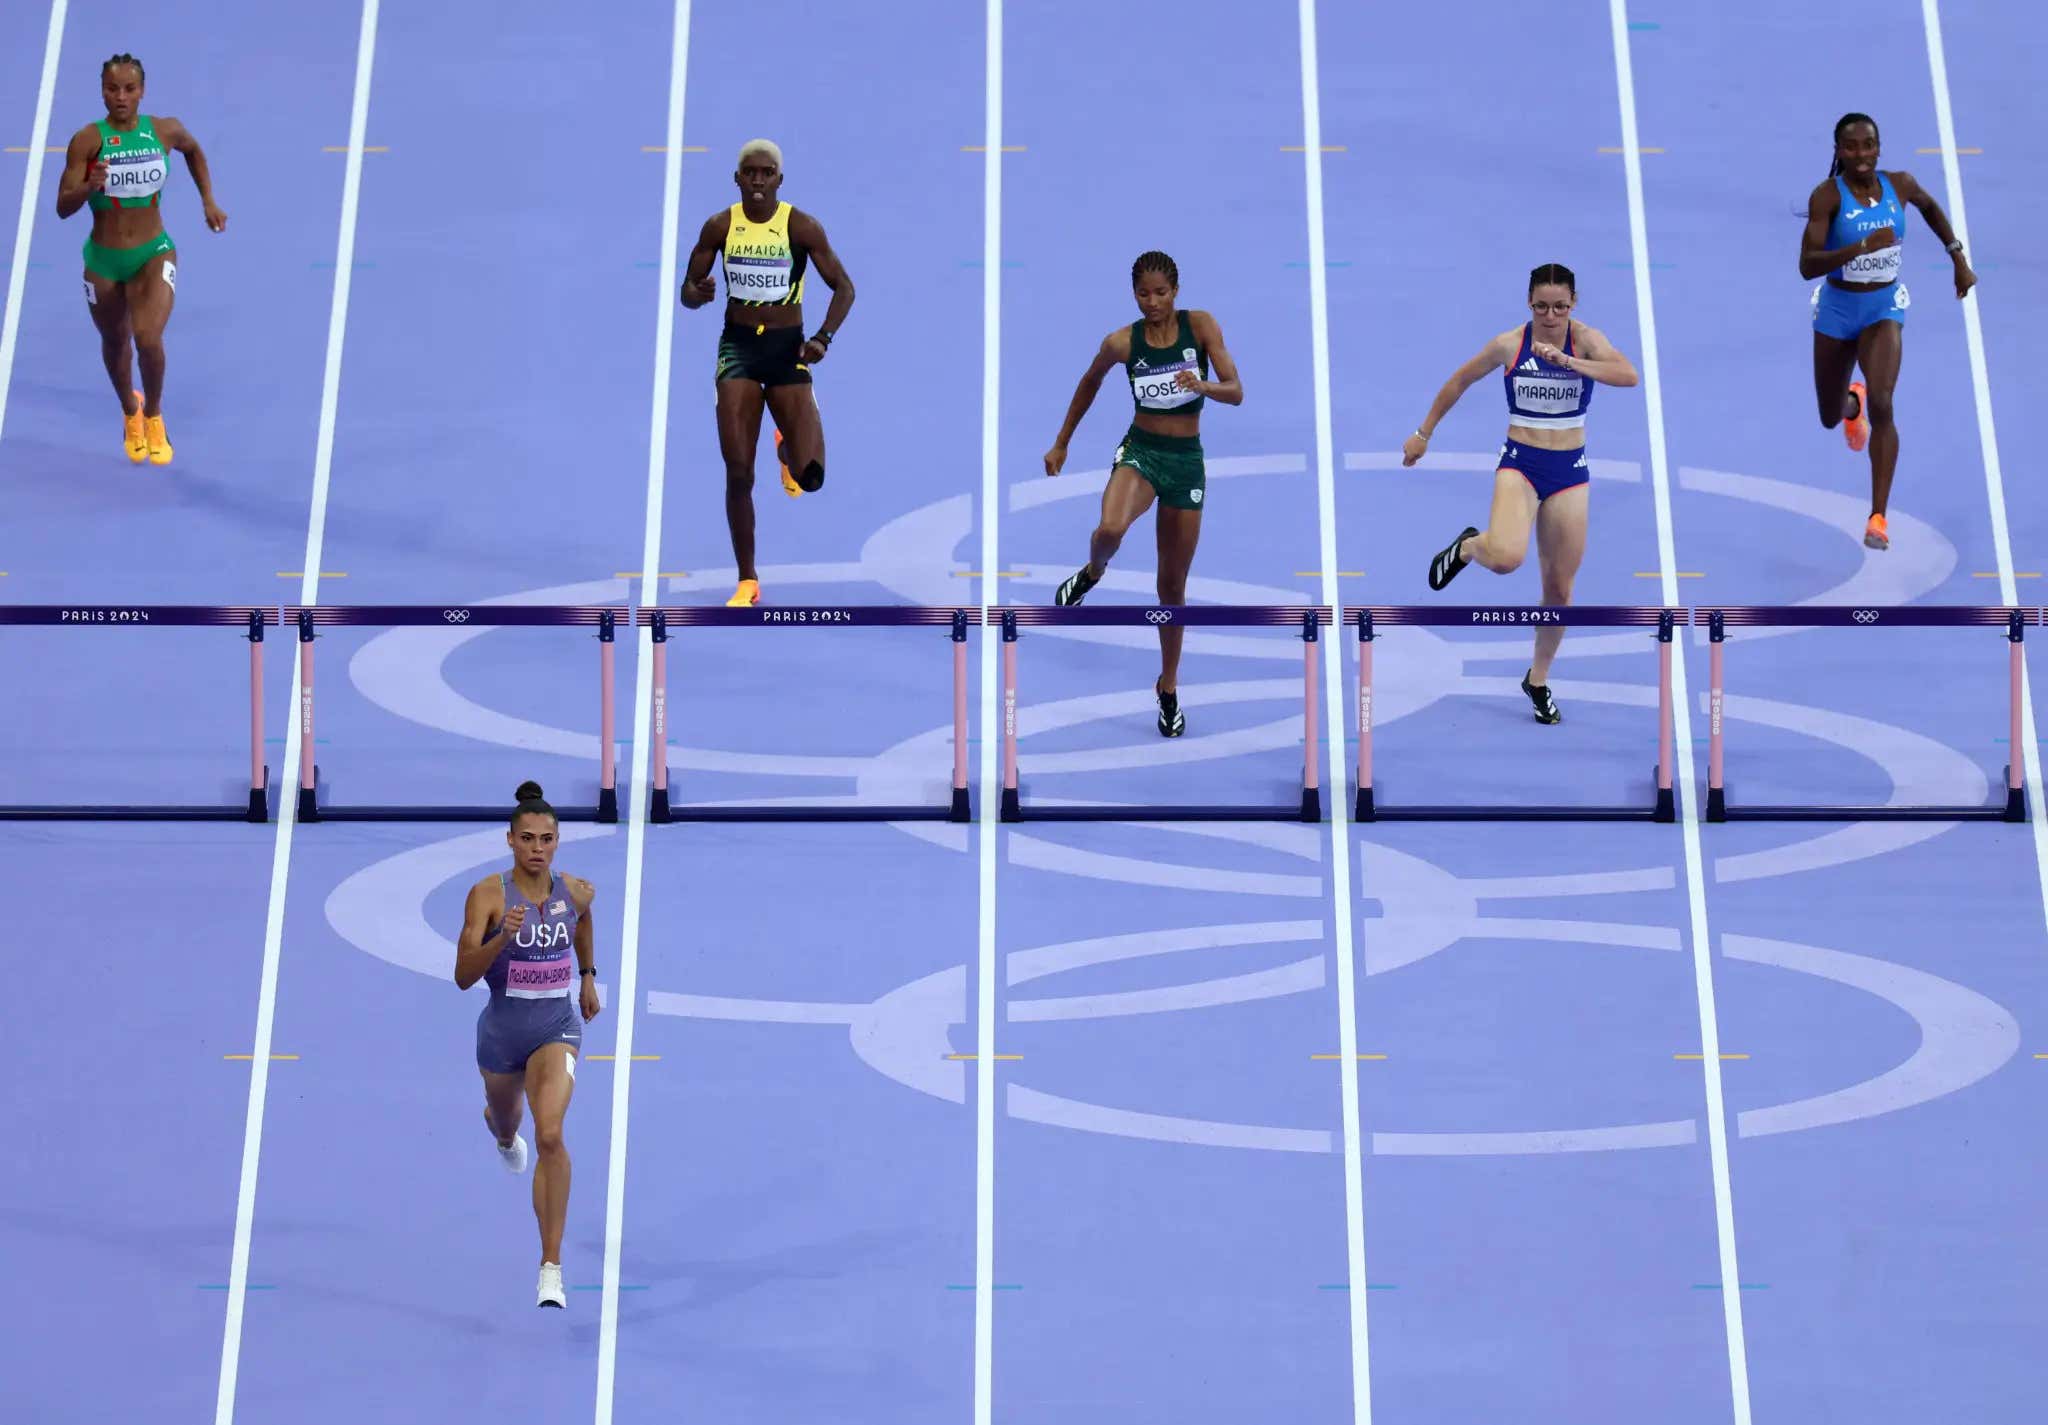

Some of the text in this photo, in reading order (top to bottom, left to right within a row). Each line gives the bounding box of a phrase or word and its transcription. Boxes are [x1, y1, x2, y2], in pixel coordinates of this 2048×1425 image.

[111, 168, 162, 186] DIALLO
[1857, 218, 1896, 232] ITALIA
[728, 244, 786, 257] JAMAICA
[729, 271, 788, 289] RUSSELL
[1139, 381, 1181, 399] JOSE
[1518, 385, 1580, 401] MARAVAL
[62, 611, 149, 621] PARIS 2024
[763, 611, 851, 622] PARIS 2024
[1472, 611, 1560, 622] PARIS 2024
[515, 921, 570, 949] USA
